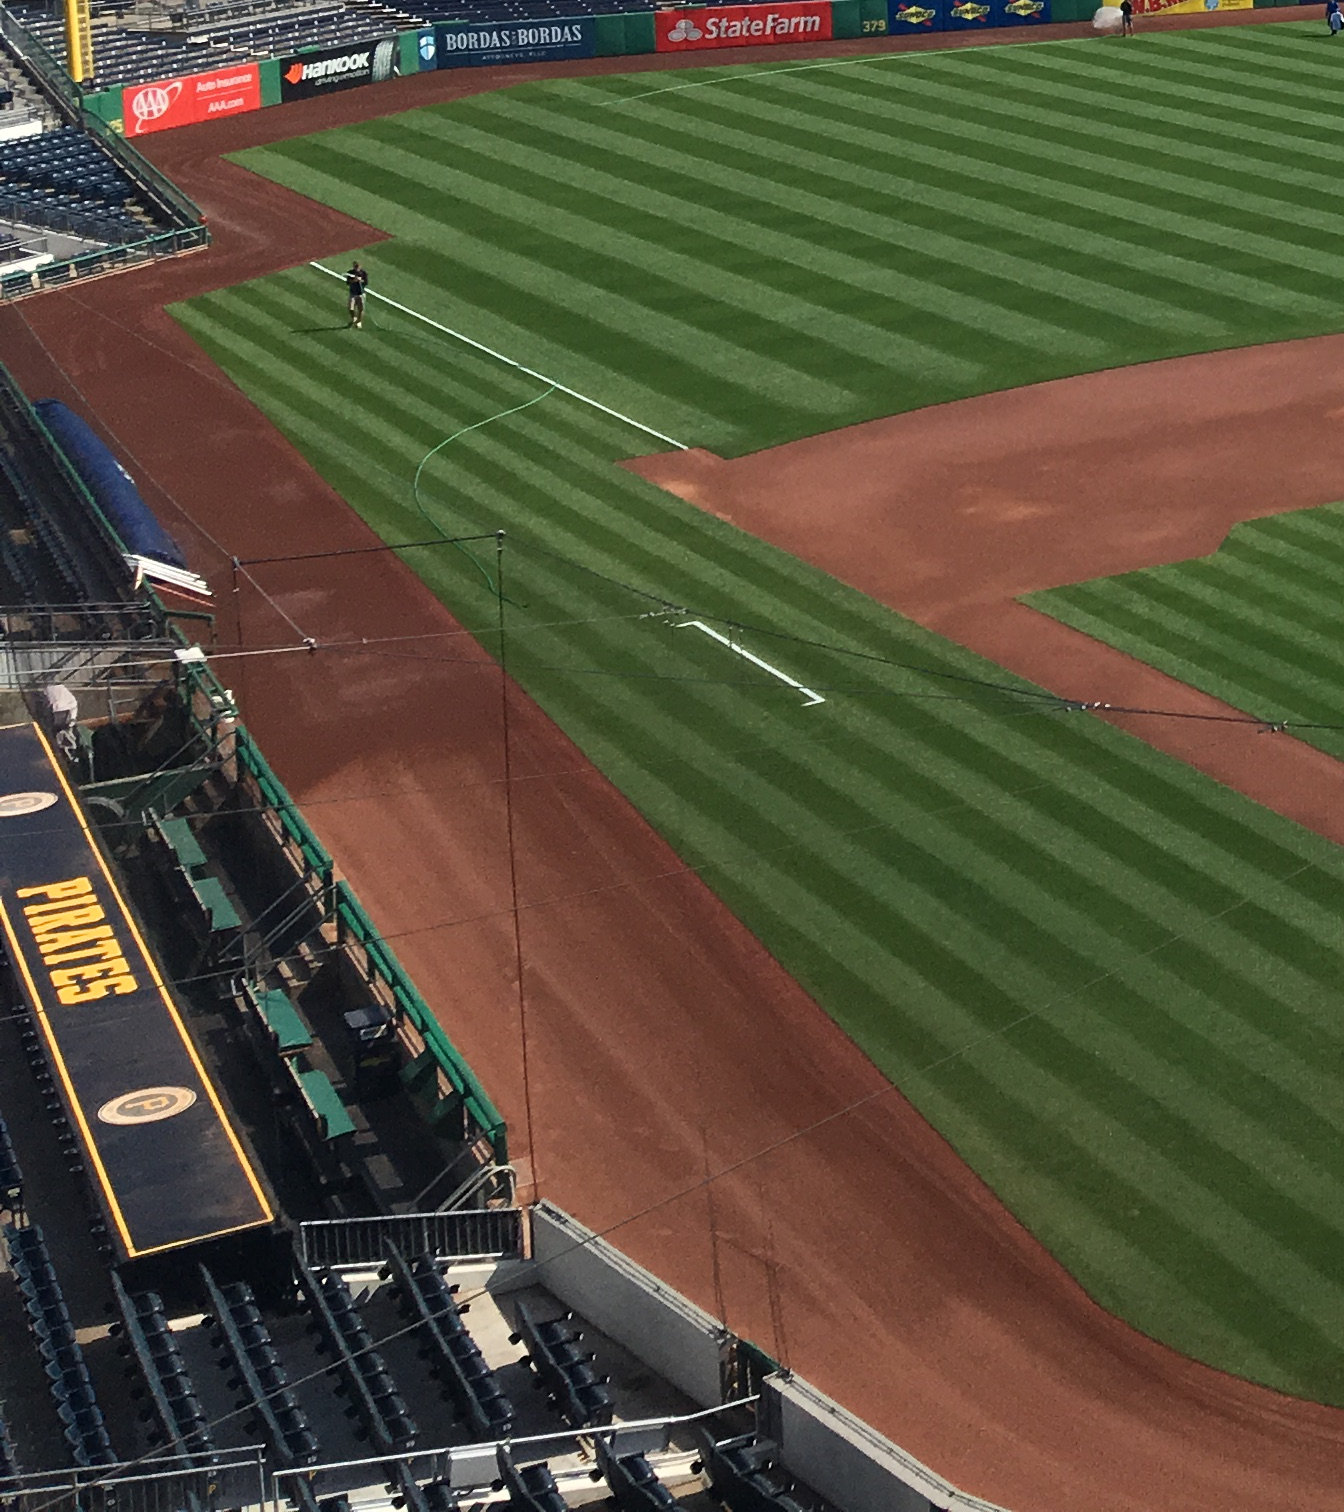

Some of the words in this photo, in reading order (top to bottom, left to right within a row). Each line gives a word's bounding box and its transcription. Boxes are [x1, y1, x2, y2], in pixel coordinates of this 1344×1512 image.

[863, 20, 886, 33] 379
[445, 30, 510, 51] BORDAS
[518, 25, 582, 46] BORDAS
[196, 80, 216, 93] Auto
[217, 74, 252, 89] Insurance
[135, 90, 168, 117] AAA
[208, 97, 244, 113] AAA.com
[16, 876, 138, 1005] PIRATES
